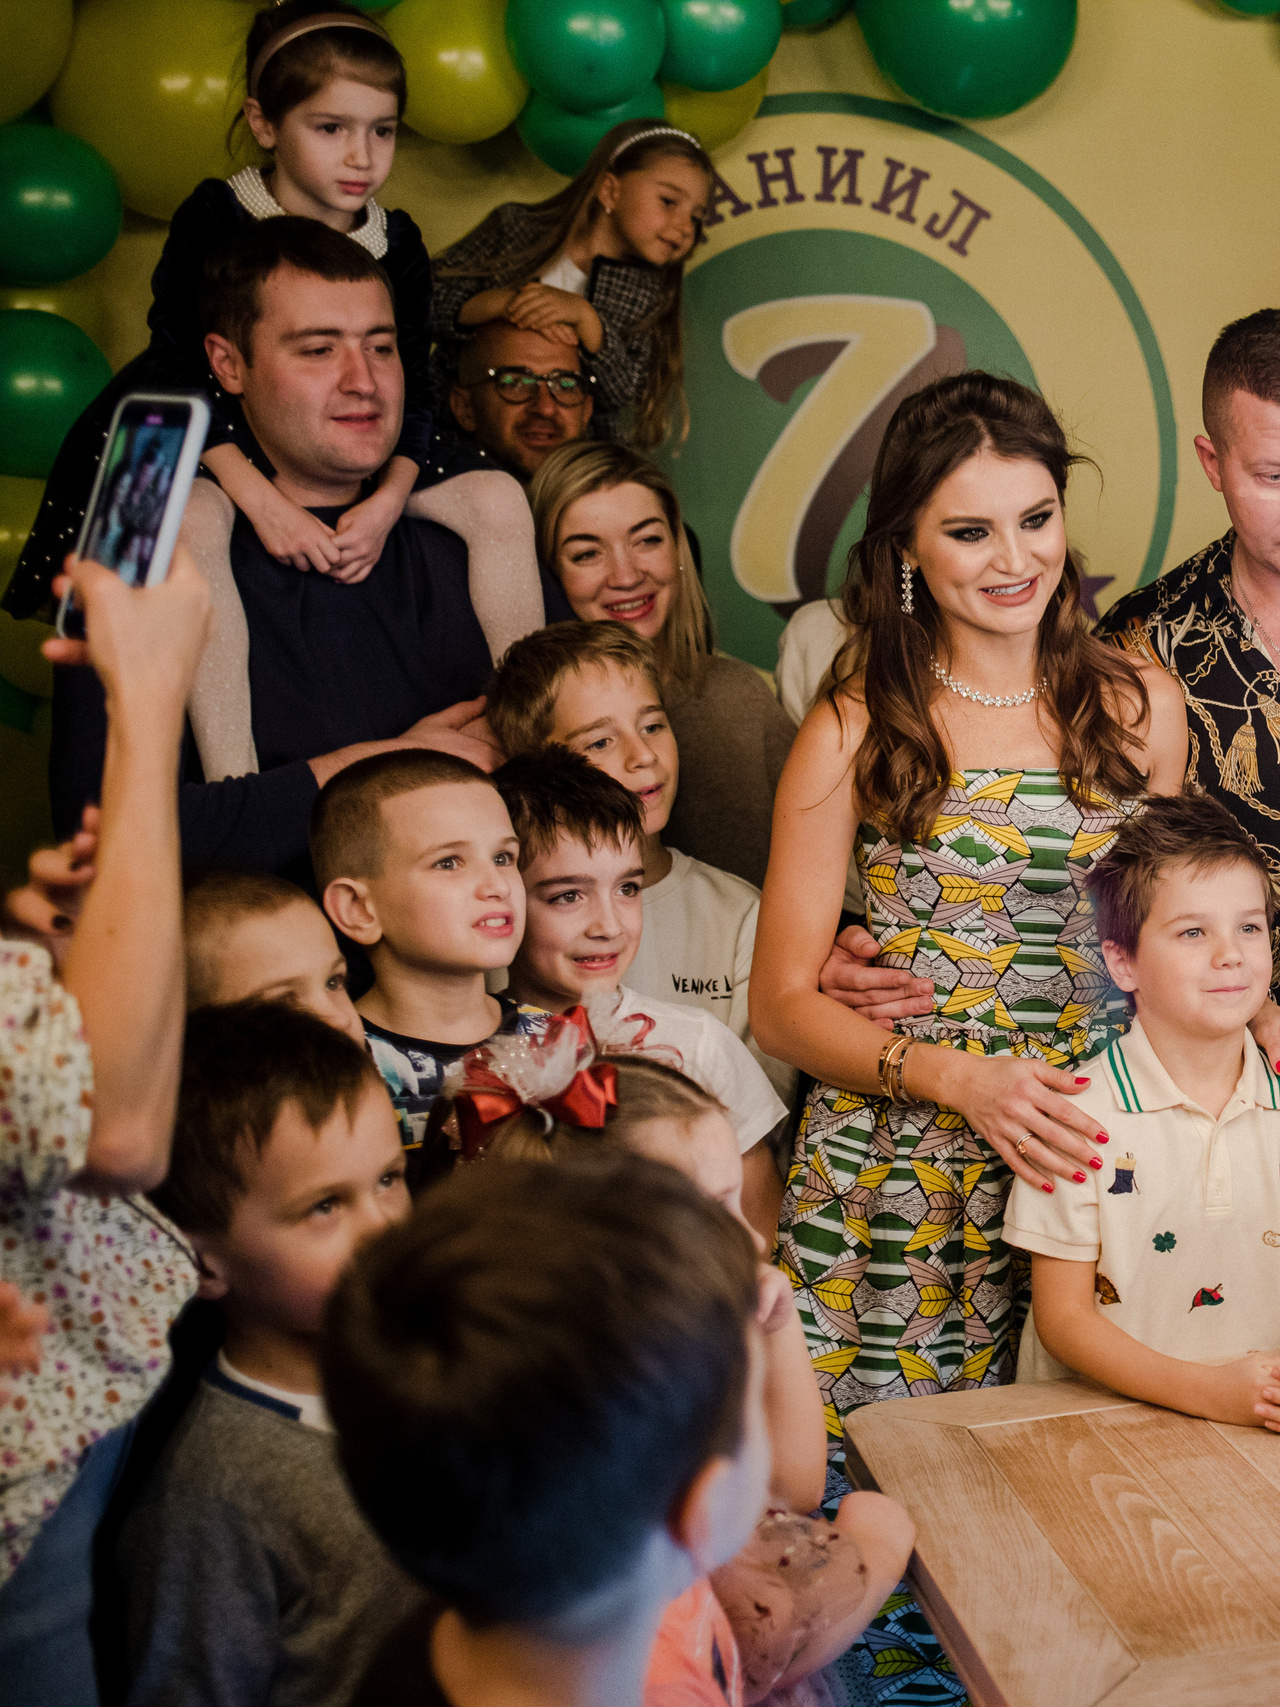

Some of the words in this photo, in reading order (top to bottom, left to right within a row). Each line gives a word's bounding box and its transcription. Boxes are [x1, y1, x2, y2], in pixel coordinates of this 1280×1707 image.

[696, 145, 992, 258] АНИИЛ
[722, 293, 937, 602] 7
[671, 973, 719, 995] VENICE
